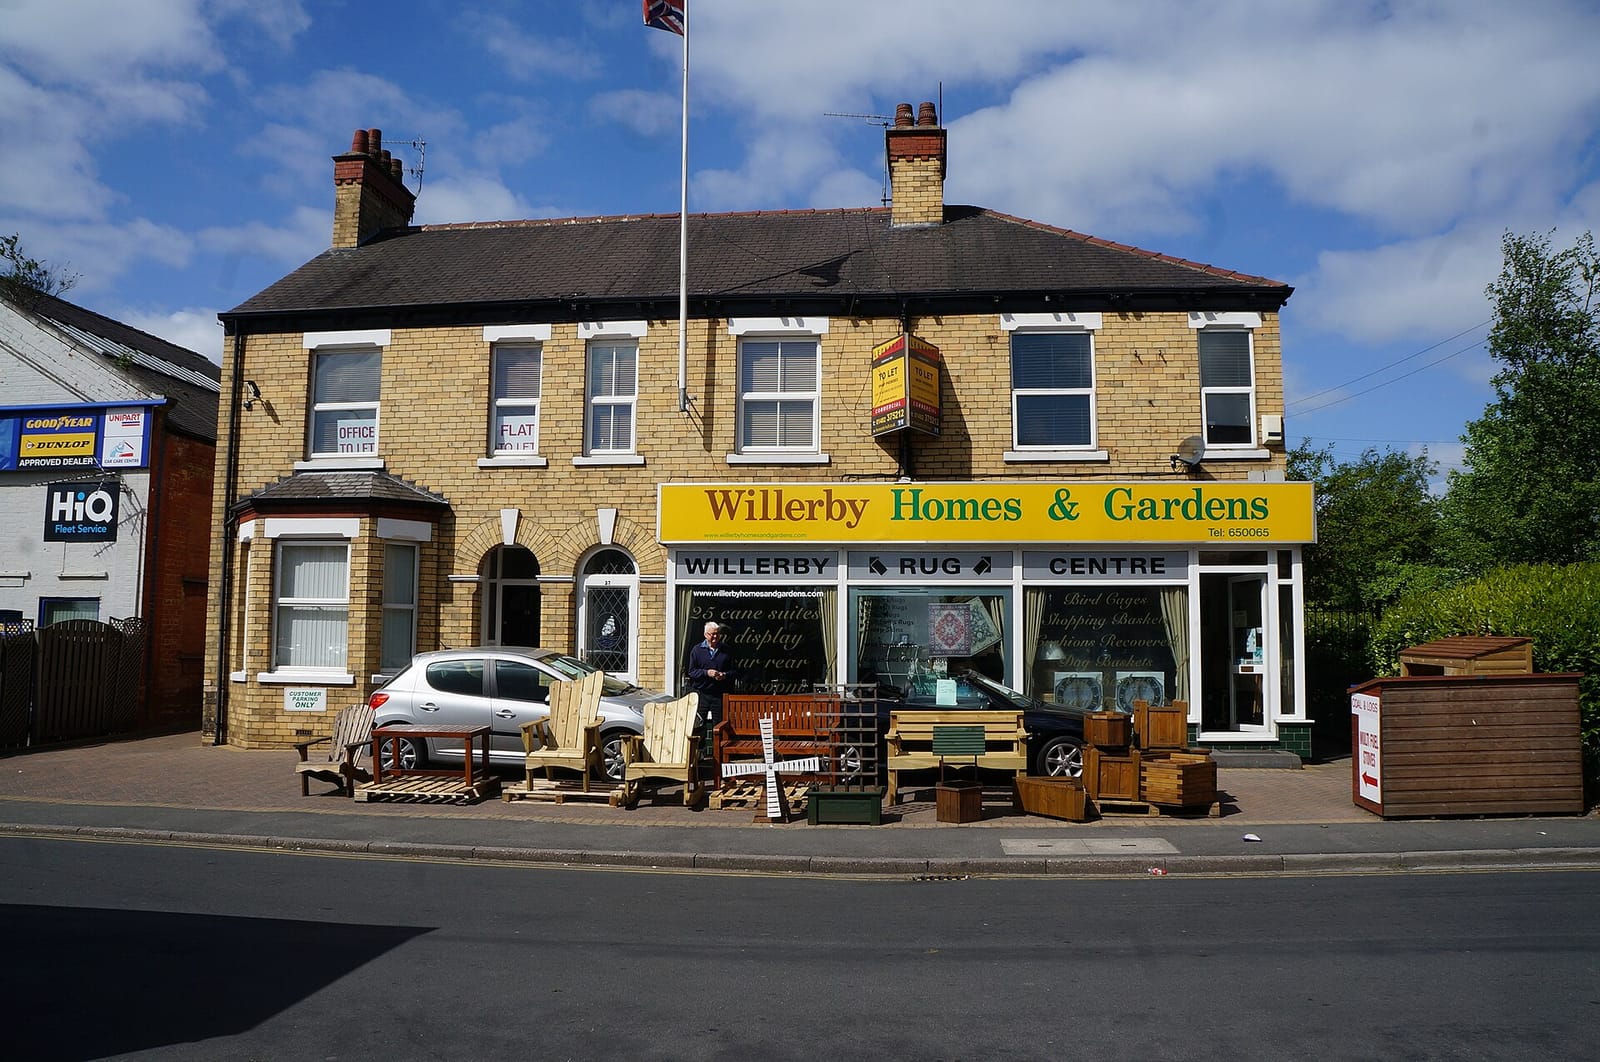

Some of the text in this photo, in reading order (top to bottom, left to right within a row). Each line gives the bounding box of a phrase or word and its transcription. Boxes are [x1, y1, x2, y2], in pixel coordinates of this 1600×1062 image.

[879, 366, 898, 380] TO LET
[915, 367, 933, 381] TO LET
[26, 416, 92, 430] GOODYEAR
[109, 414, 140, 422] UNIPART
[339, 426, 375, 439] OFFICE
[500, 424, 535, 436] FLAT
[36, 440, 90, 449] DUNLOP
[19, 457, 94, 467] APPROVED DEALER
[52, 490, 113, 524] HiQ
[704, 487, 1269, 529] Willerby Homes & Gardens
[54, 524, 107, 534] Fleet Service
[1208, 528, 1270, 538] Tel: 650065
[684, 557, 830, 575] WILLERBY
[900, 557, 961, 575] RUG
[1049, 556, 1166, 575] CENTRE
[692, 590, 824, 598] www.willerbyhomesandgardens.com
[1064, 592, 1148, 610] Bird Cages
[690, 605, 820, 620] 25 cane suites
[1042, 612, 1168, 631] Shopping Basket
[734, 626, 804, 650] display
[764, 658, 809, 670] rear
[1060, 654, 1153, 671] Dog Baskets
[1366, 702, 1378, 713] LOGS
